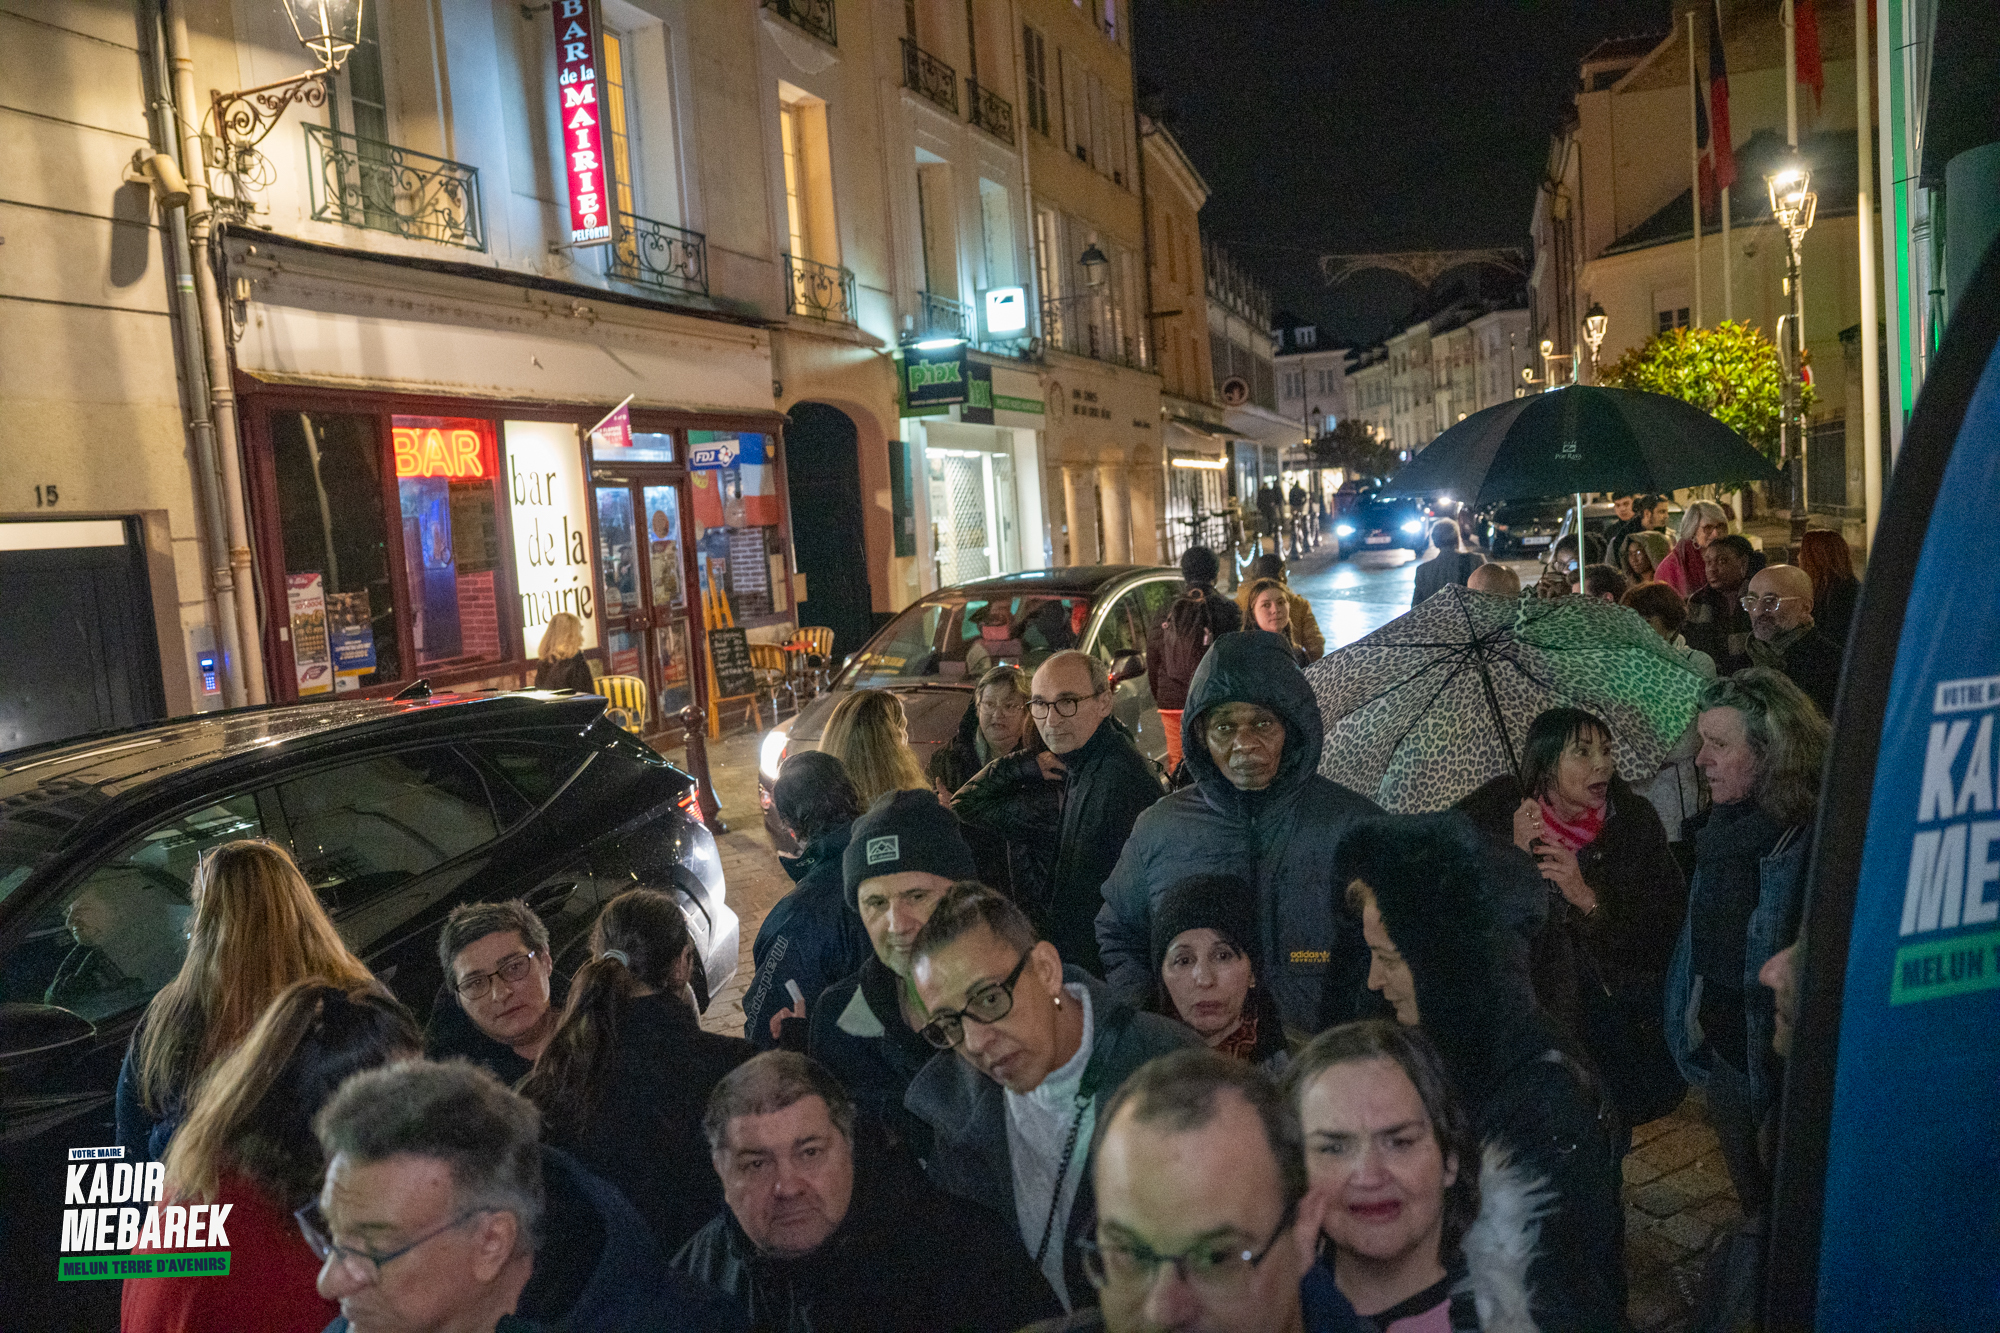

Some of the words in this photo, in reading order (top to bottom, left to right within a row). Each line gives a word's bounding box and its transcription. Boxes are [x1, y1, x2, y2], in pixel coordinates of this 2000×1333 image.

[561, 0, 589, 63] BAR
[560, 68, 578, 86] de
[580, 64, 595, 82] la
[564, 83, 600, 215] MAIRIE
[571, 226, 609, 243] PELFORTH
[392, 428, 483, 478] BAR
[695, 450, 716, 463] FDJ
[34, 485, 59, 508] 15
[510, 454, 557, 506] bar
[528, 517, 556, 567] de
[562, 515, 588, 566] la
[520, 576, 593, 628] mairie
[1290, 950, 1320, 959] adidas
